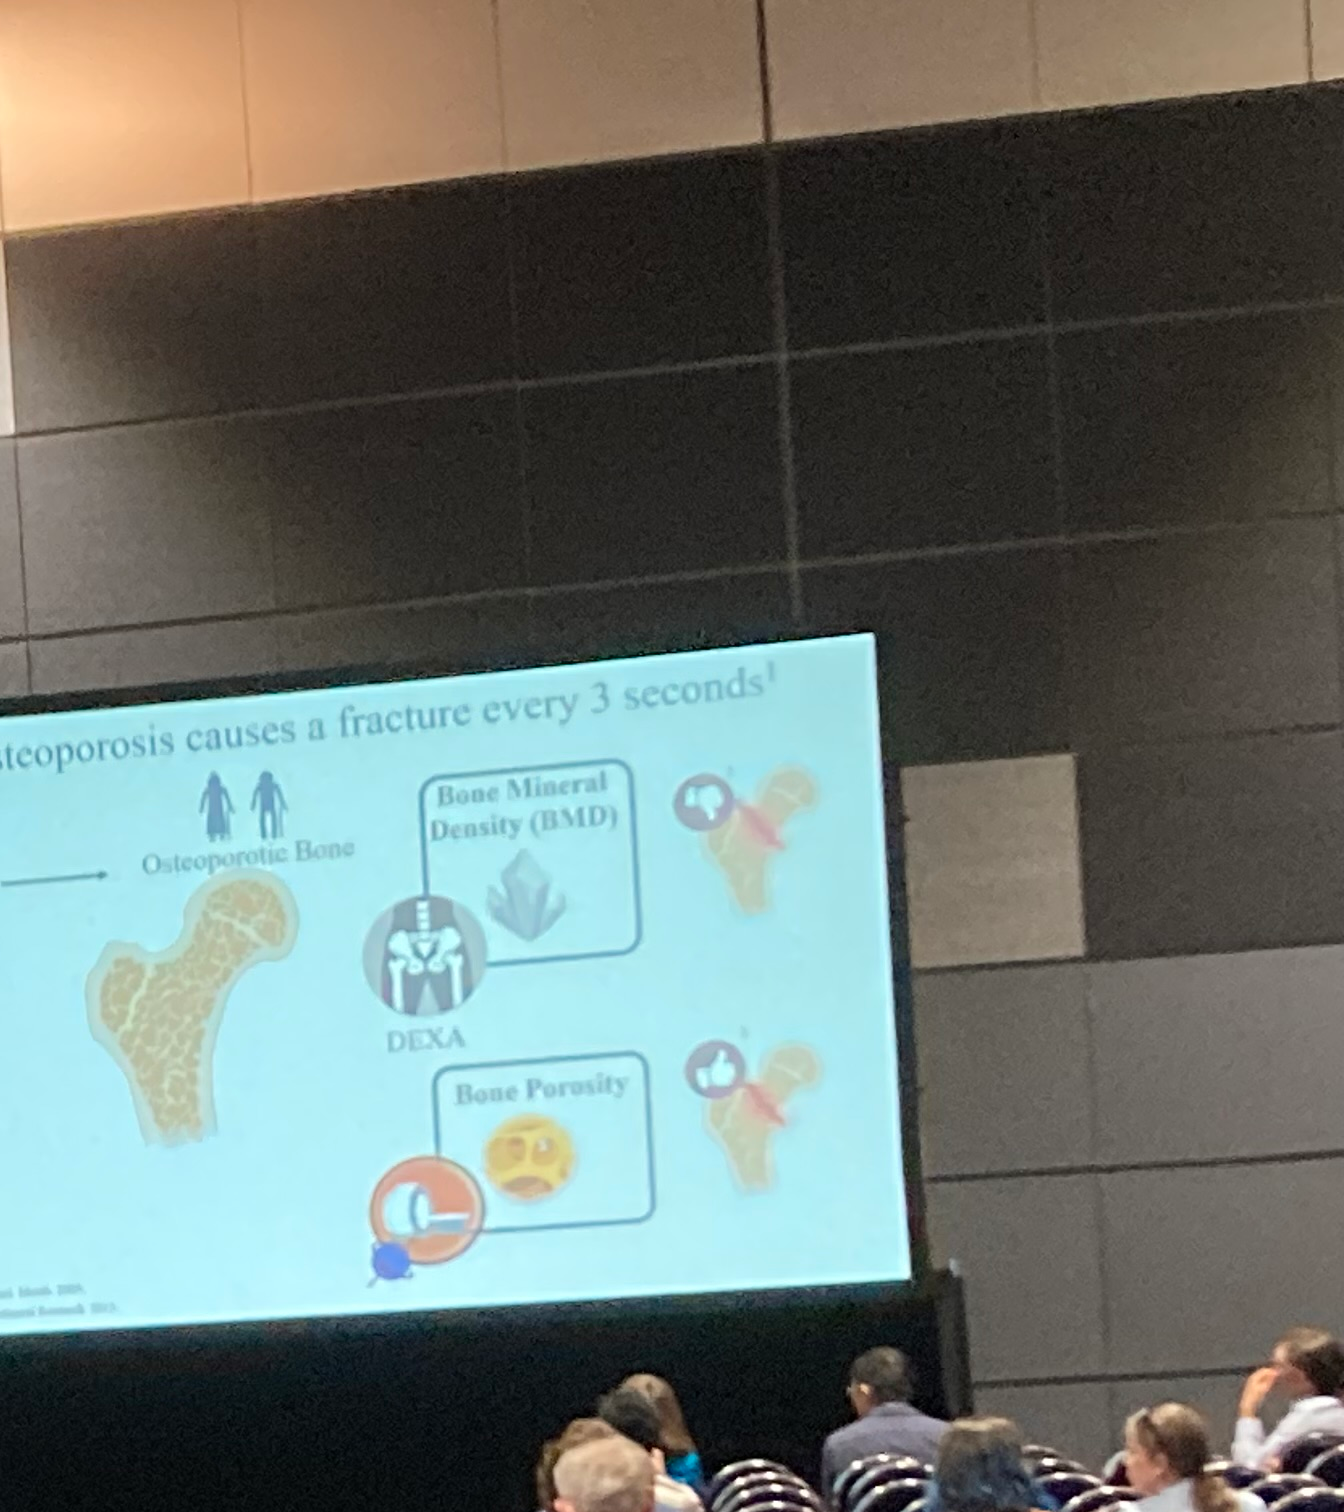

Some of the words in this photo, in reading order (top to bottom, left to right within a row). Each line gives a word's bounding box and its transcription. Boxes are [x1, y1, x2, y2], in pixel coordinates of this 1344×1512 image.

[185, 720, 297, 752] causes
[308, 717, 326, 741] a
[338, 701, 472, 738] fracture
[483, 688, 578, 725] every
[589, 681, 612, 714] 3
[437, 785, 499, 809] Bone
[507, 771, 609, 803] Mineral
[429, 813, 522, 843] Density
[529, 805, 618, 837] (BMD)
[141, 842, 289, 876] Osteoporotic
[294, 838, 356, 863] Bone
[386, 1027, 467, 1054] DEXA
[454, 1081, 518, 1106] Bone
[525, 1072, 630, 1101] Porosity
